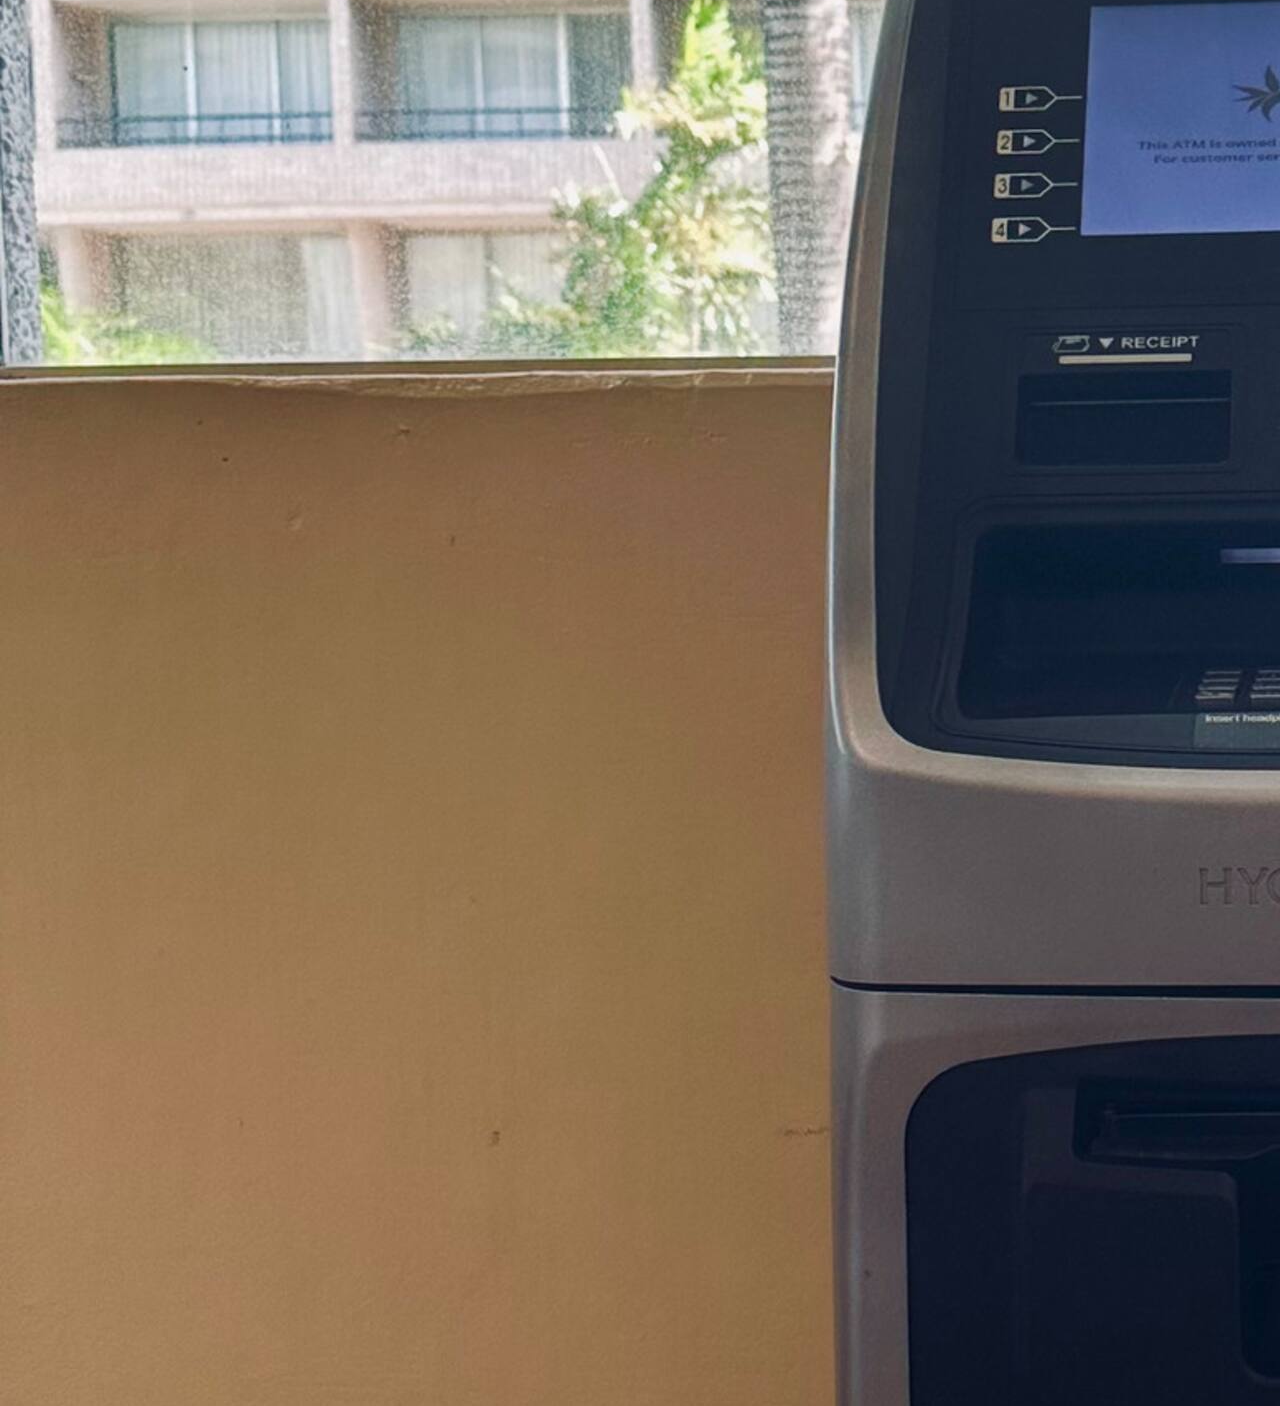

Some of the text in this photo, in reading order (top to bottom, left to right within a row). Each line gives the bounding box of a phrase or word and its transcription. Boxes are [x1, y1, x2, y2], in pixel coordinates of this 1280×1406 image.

[1000, 135, 1011, 150] 2
[1138, 140, 1169, 150] This
[1173, 139, 1206, 149] ATM
[1209, 139, 1221, 148] is
[1225, 138, 1277, 148] owned
[1154, 154, 1176, 163] For
[1182, 152, 1252, 163] customer
[997, 178, 1008, 193] 3
[995, 223, 1005, 237] 4
[1121, 335, 1200, 349] RECEIPT
[1205, 714, 1239, 723] Insert
